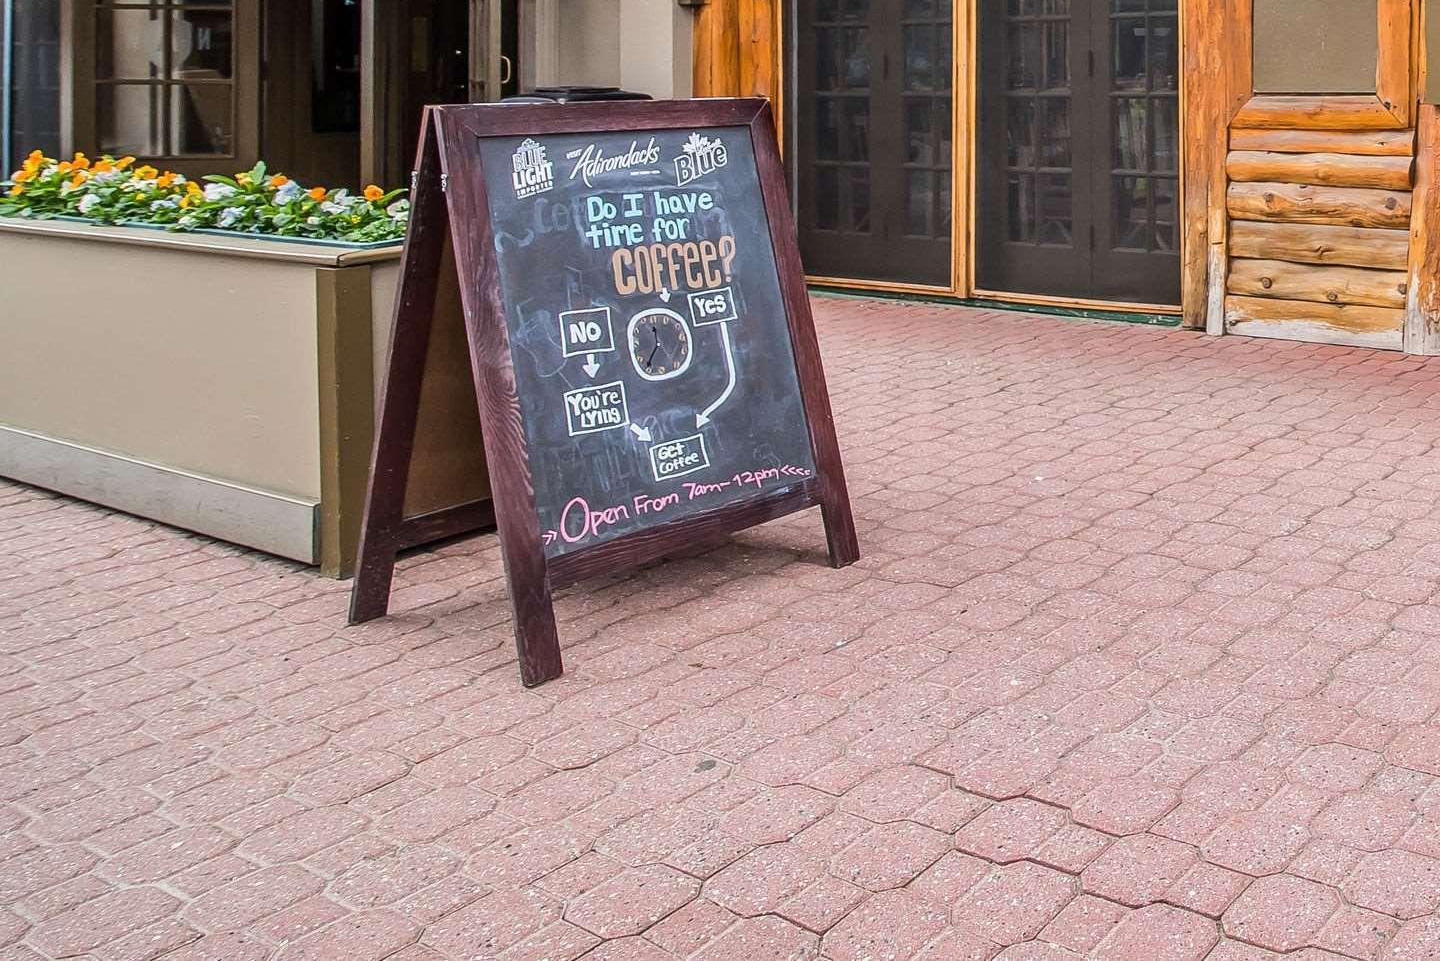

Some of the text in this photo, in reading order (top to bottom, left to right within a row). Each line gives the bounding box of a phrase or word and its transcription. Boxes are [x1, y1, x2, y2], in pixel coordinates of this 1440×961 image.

[512, 146, 547, 172] BLUE
[570, 137, 661, 188] Adirondacks
[673, 144, 727, 187] Blue
[512, 161, 554, 190] LIGHT
[586, 191, 713, 222] Do I have
[585, 217, 690, 248] time for
[568, 391, 622, 414] You're
[560, 497, 629, 543] Open
[633, 493, 679, 515] From
